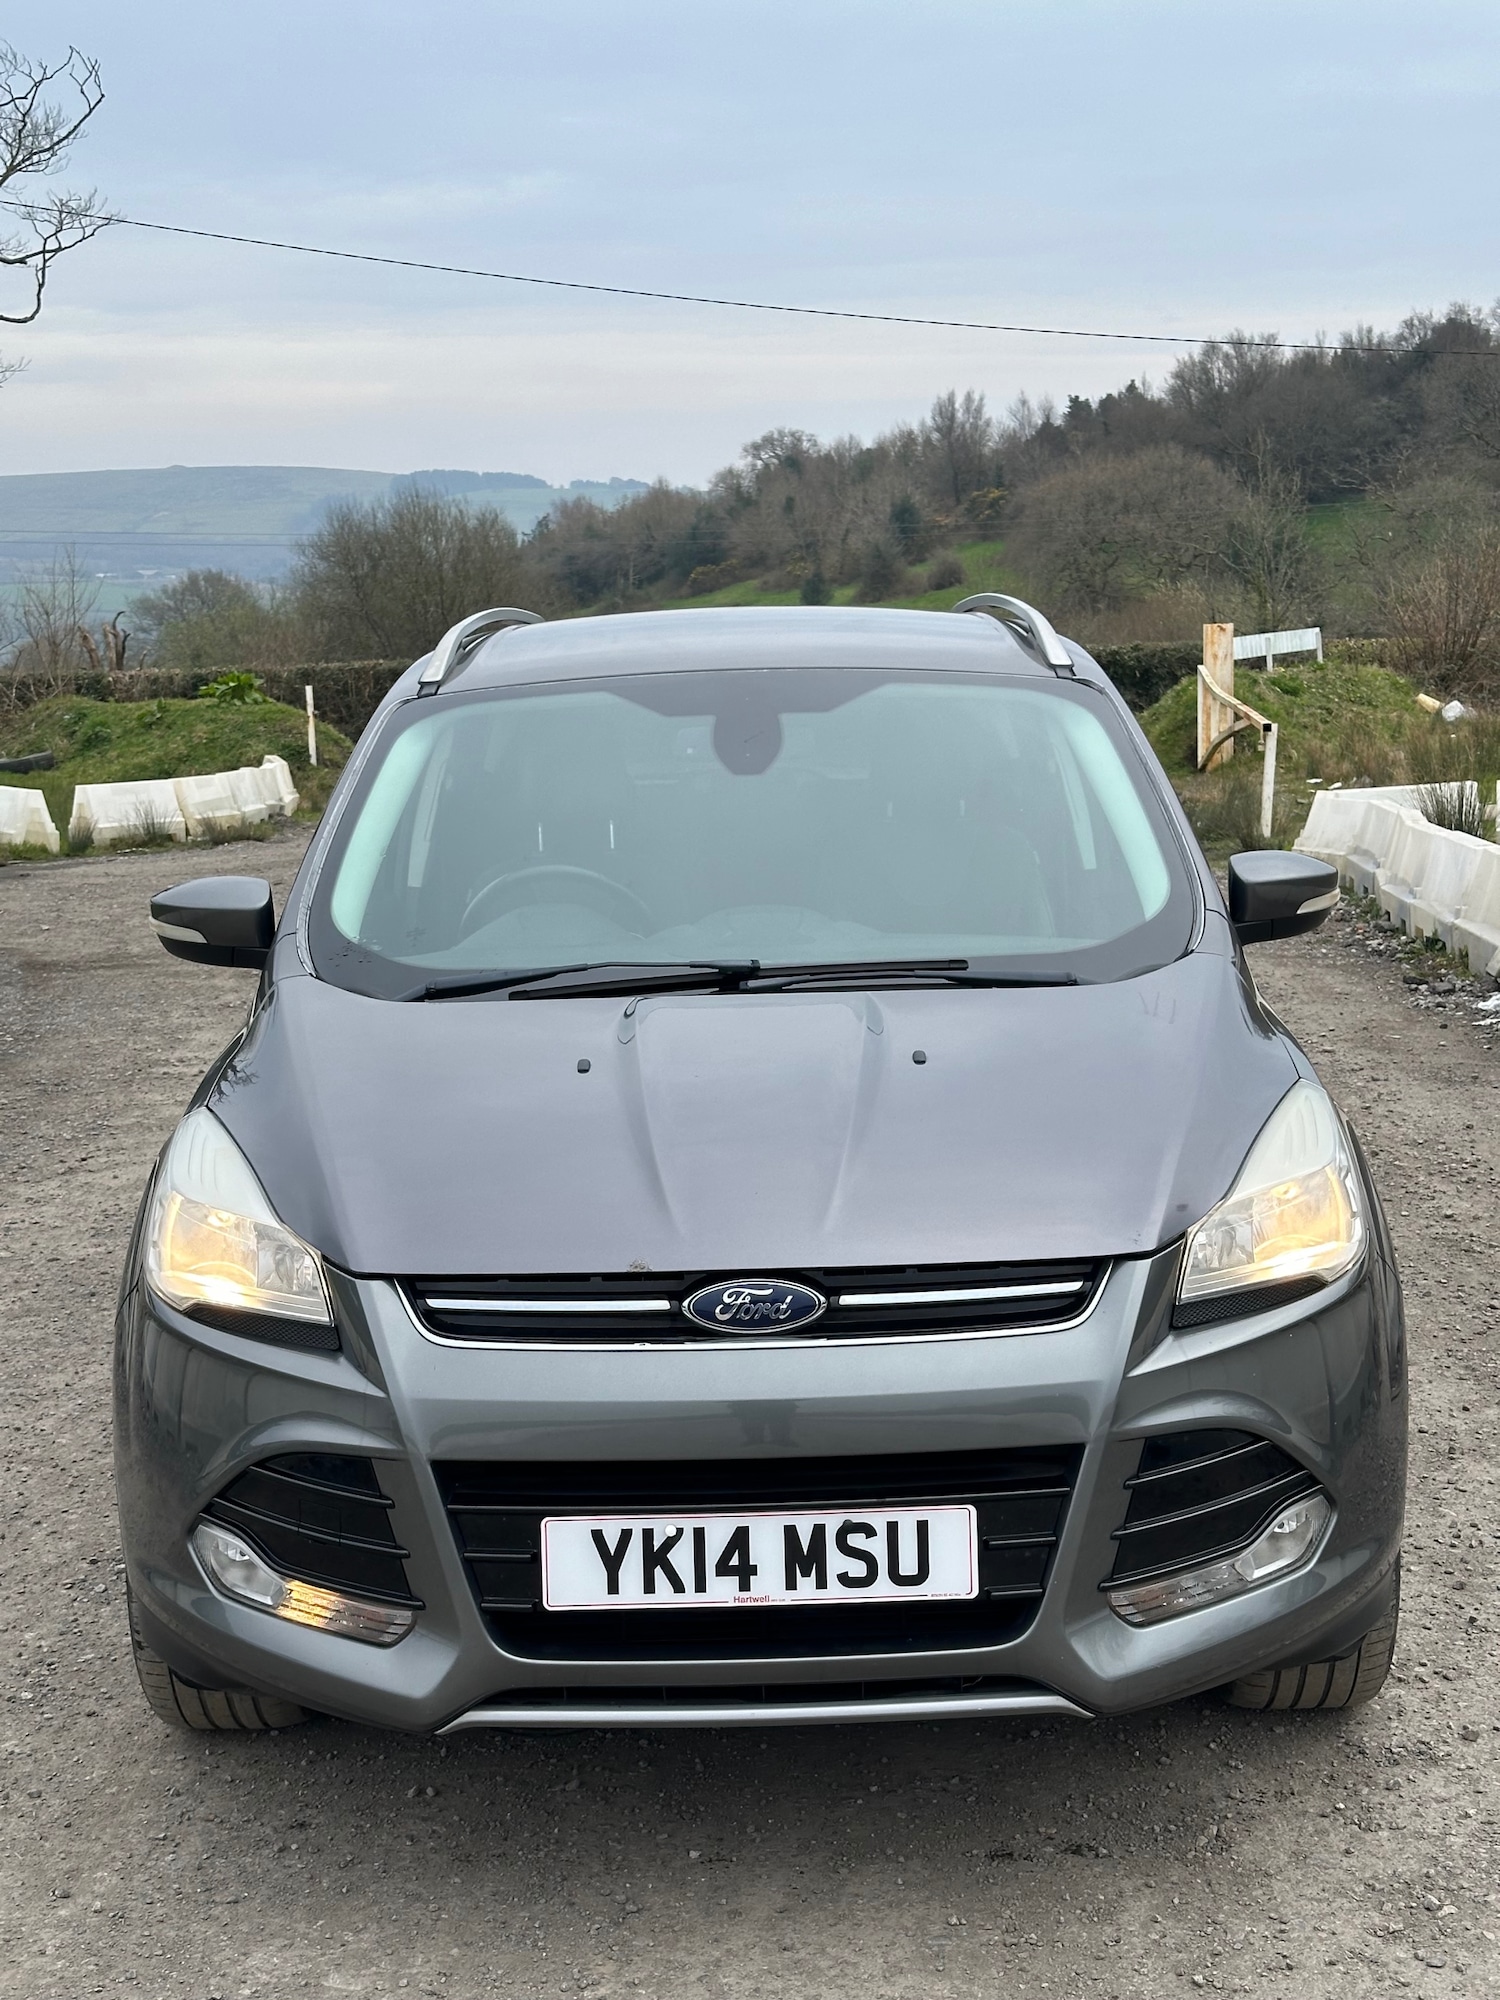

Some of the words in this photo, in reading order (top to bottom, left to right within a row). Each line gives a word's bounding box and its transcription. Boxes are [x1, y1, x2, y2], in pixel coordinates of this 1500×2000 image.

[715, 1288, 793, 1320] Ford
[590, 1526, 758, 1595] YK14
[783, 1520, 929, 1590] MSU
[733, 1595, 770, 1603] Hartwell
